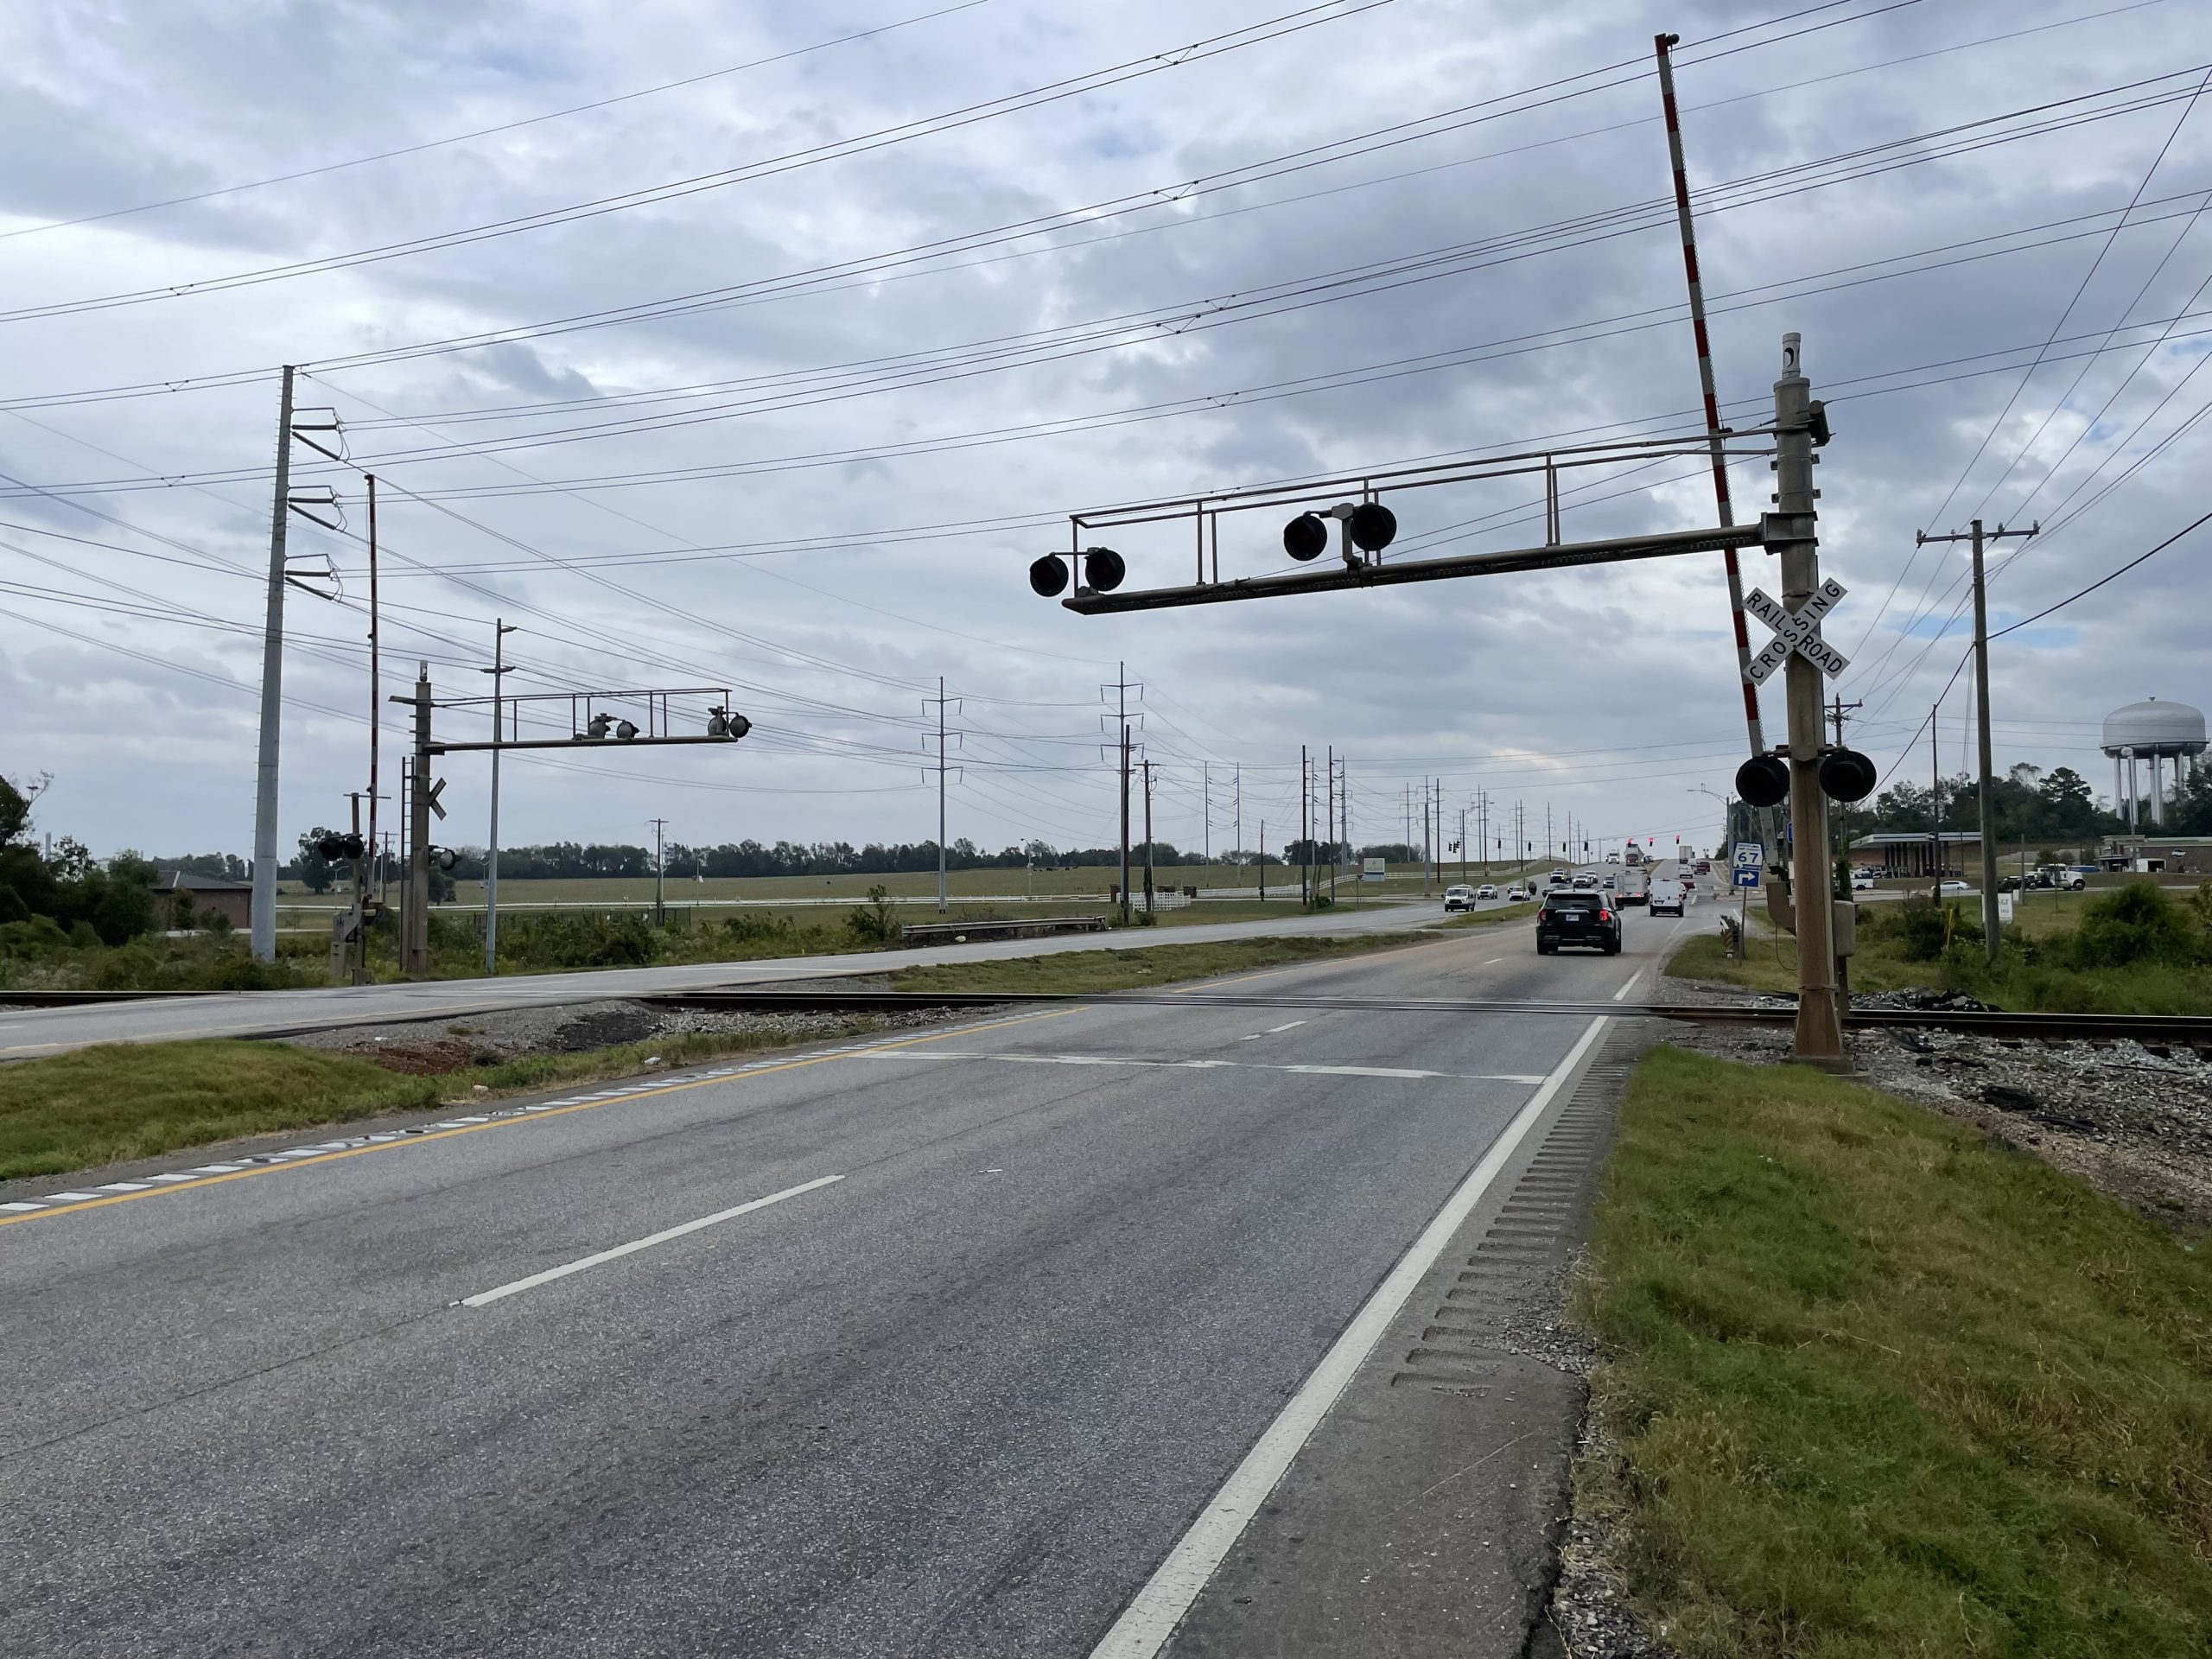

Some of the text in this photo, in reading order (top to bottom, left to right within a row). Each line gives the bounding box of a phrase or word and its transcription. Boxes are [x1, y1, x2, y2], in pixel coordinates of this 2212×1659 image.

[1747, 593, 1843, 673] RAIL ROAD
[1750, 584, 1840, 679] CROSSING
[1738, 852, 1758, 863] 67
